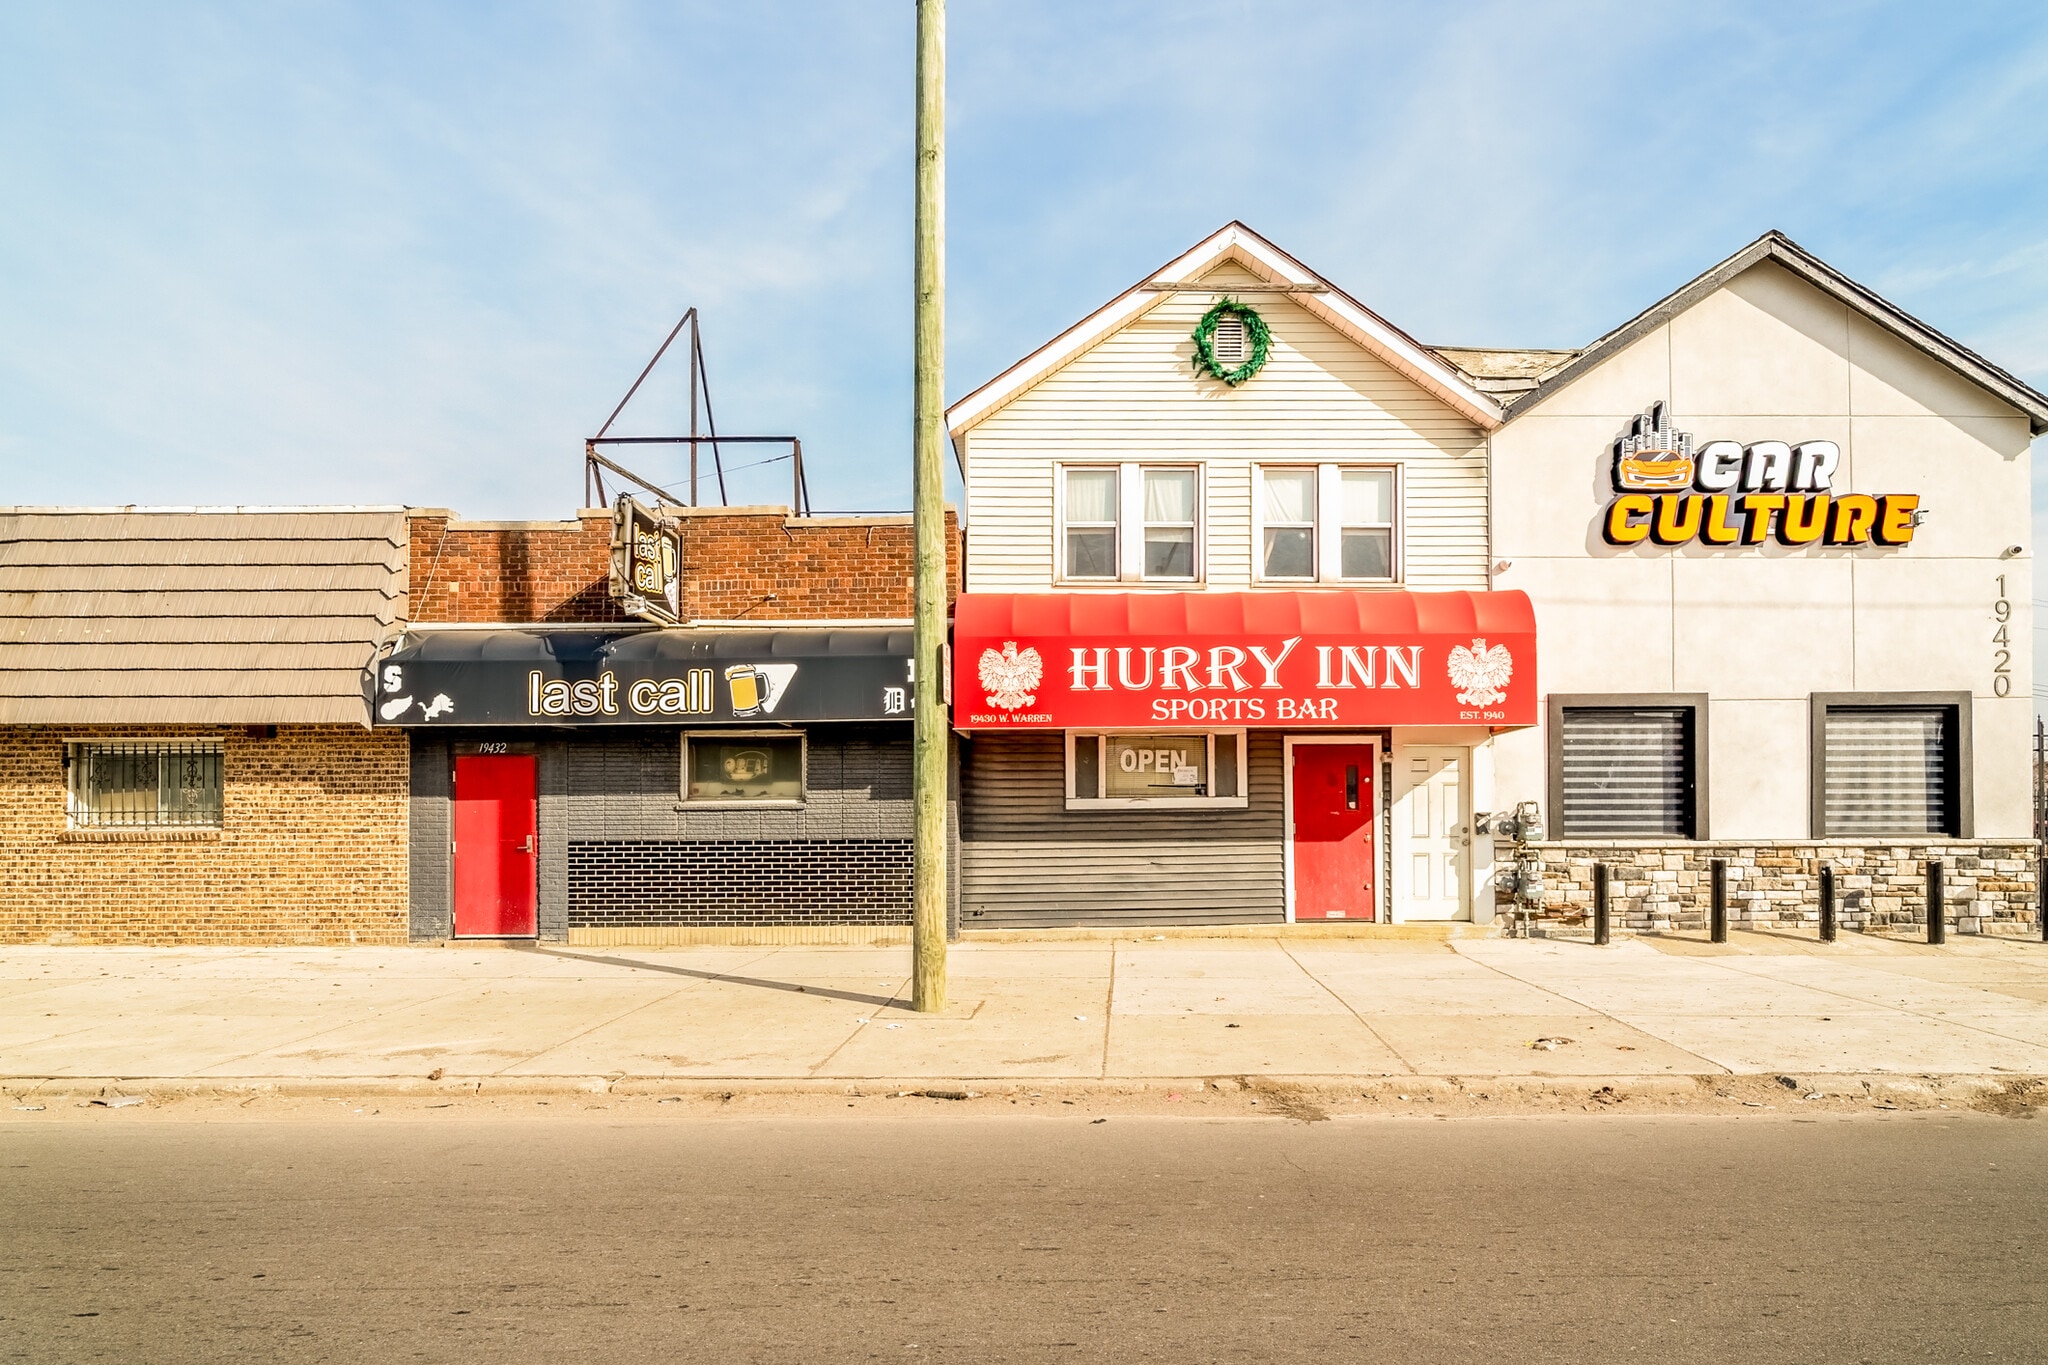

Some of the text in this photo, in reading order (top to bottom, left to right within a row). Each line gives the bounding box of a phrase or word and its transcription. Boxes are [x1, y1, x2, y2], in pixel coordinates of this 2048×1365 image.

[1701, 440, 1839, 489] CAR
[1609, 494, 1920, 544] CULTURE
[633, 522, 662, 563] last
[635, 562, 663, 594] call
[1992, 574, 2012, 698] 19420
[383, 665, 402, 693] S
[1067, 636, 1425, 693] HURRY INN
[528, 668, 714, 716] last call
[883, 686, 906, 715] D
[970, 713, 1052, 723] 19430 W. WARREN
[1151, 698, 1339, 721] SPORTS BAR
[1460, 711, 1505, 720] EST. 1940
[480, 742, 507, 753] 19432
[1120, 749, 1187, 774] OPEN
